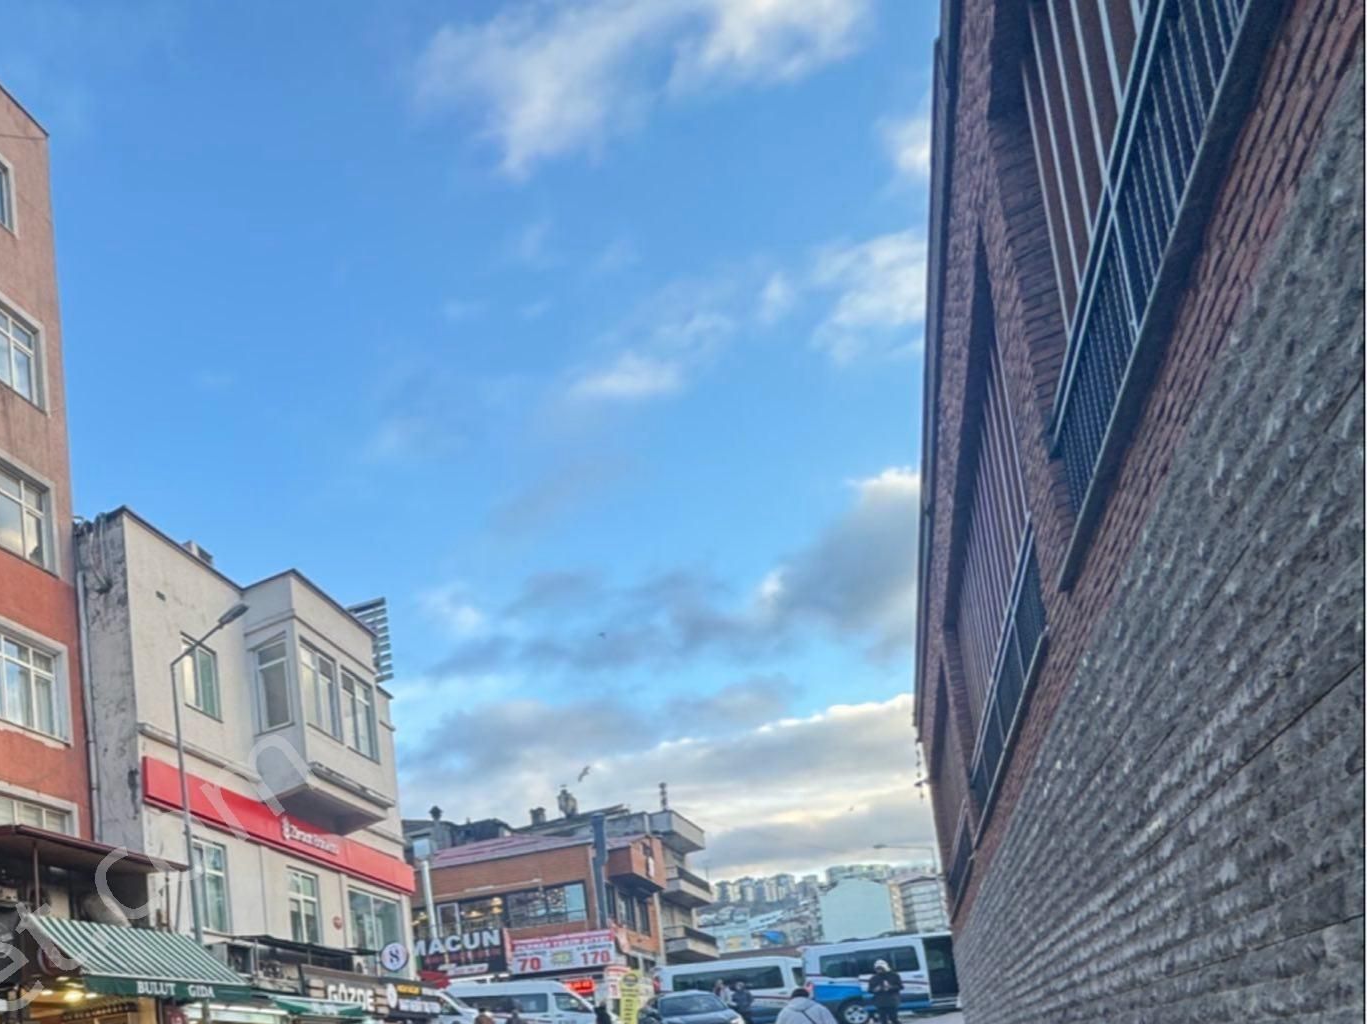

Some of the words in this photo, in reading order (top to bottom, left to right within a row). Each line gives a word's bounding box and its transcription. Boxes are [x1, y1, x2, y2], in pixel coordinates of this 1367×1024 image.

[517, 956, 542, 972] 70
[580, 950, 611, 965] 170
[136, 980, 176, 996] BULUT
[187, 984, 216, 998] GIDA
